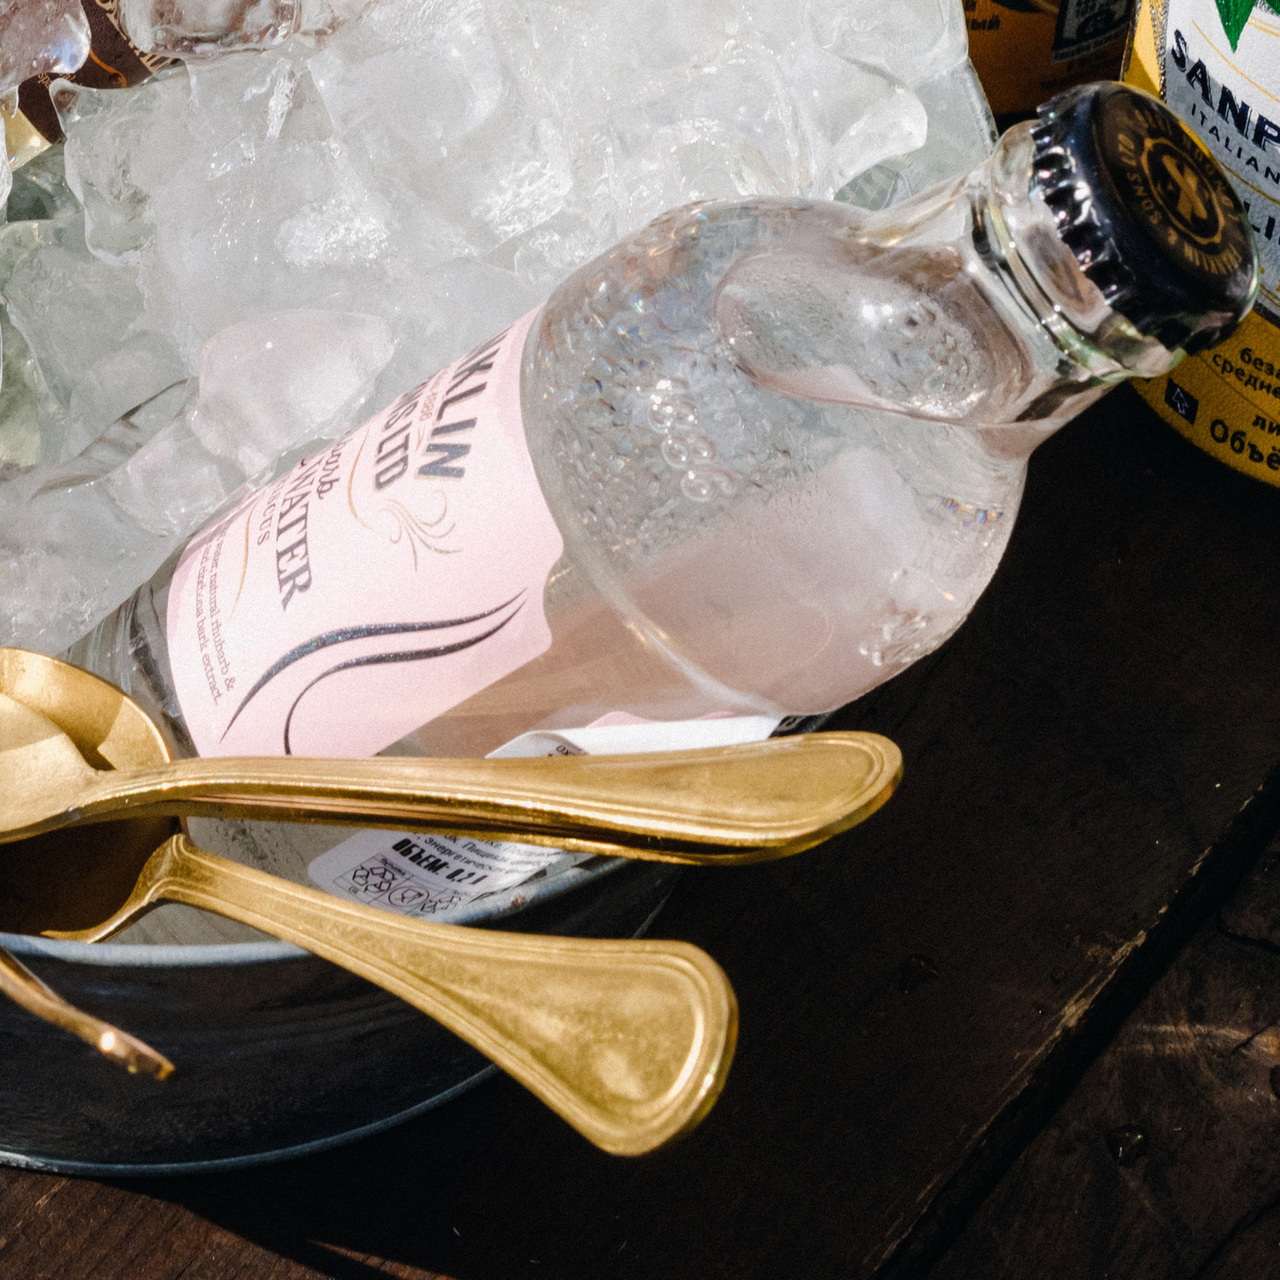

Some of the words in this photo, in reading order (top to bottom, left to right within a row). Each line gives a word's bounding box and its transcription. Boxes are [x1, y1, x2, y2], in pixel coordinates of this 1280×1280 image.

[375, 419, 412, 491] LTD
[195, 615, 210, 653] bark
[210, 618, 231, 678] rhubarb
[224, 676, 237, 693] &
[201, 652, 224, 707] extract.
[391, 837, 450, 877] ОБЪЕМ:
